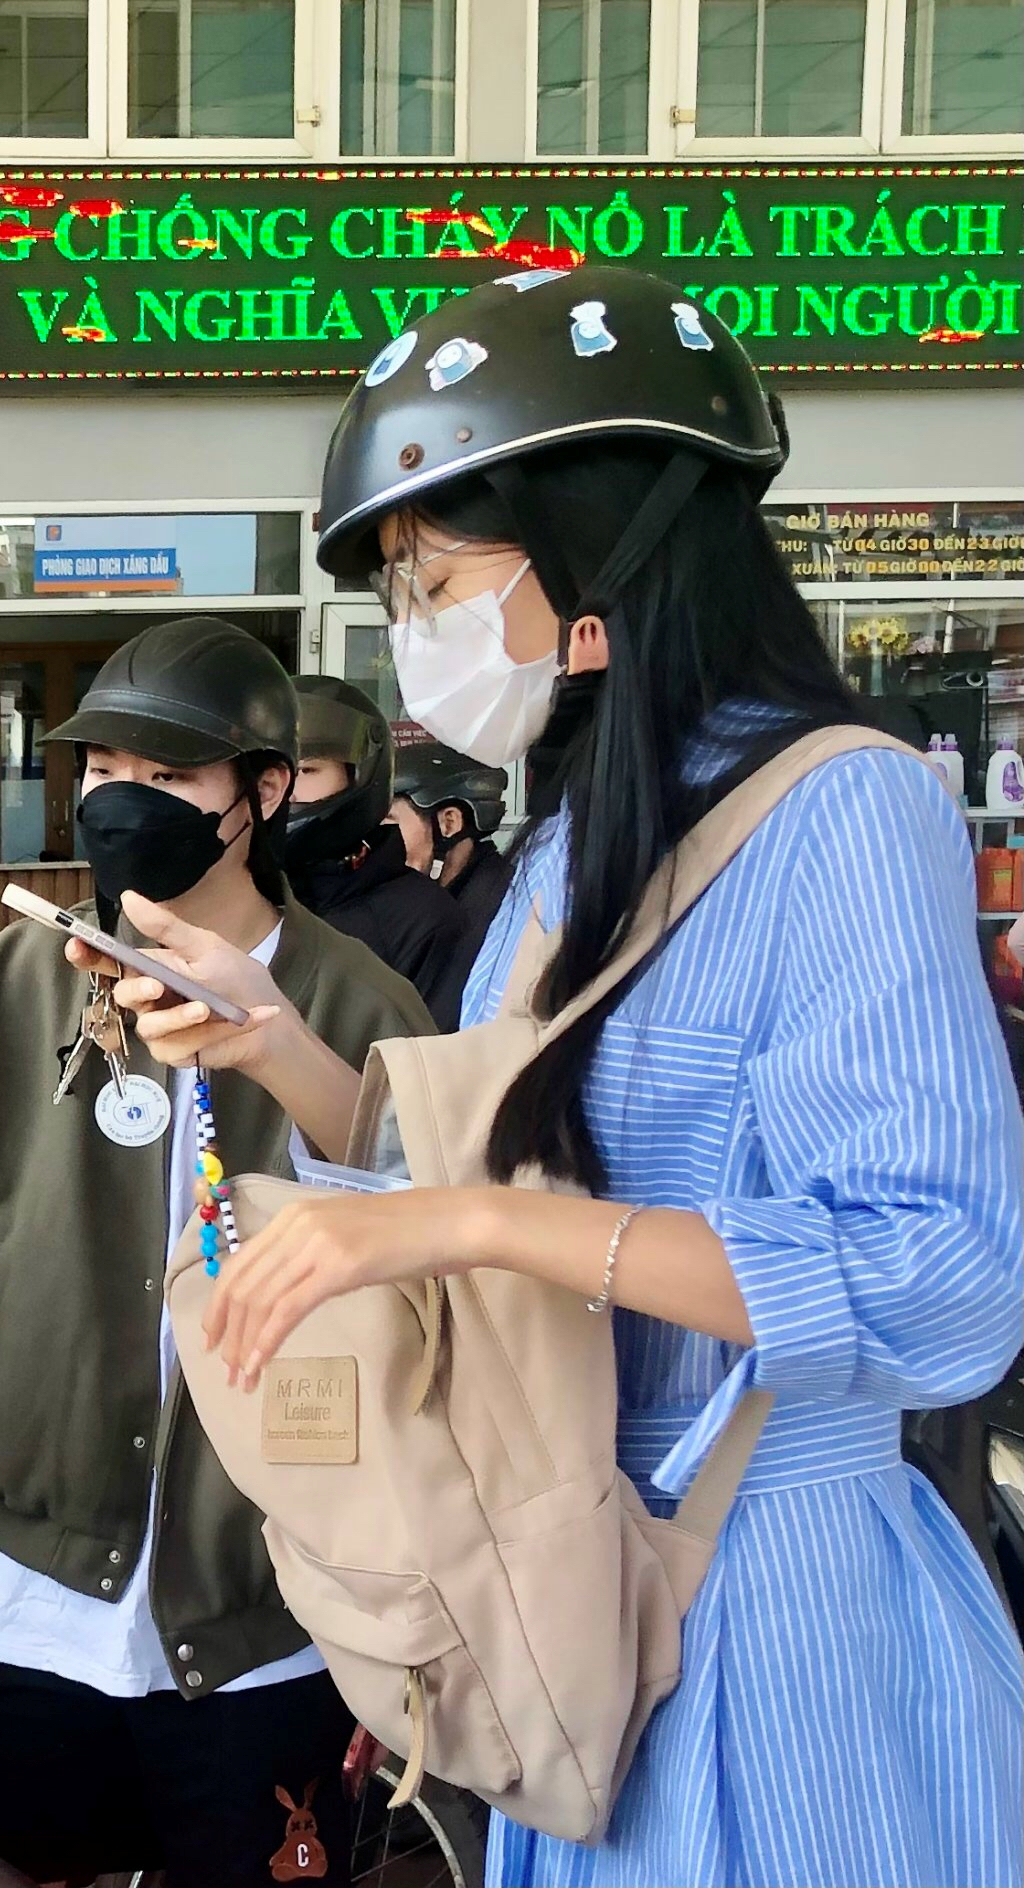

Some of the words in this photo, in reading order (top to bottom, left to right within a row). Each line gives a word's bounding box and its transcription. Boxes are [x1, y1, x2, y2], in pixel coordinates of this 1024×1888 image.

[54, 192, 313, 261] CHỐNG
[329, 190, 530, 260] CHÁY
[662, 190, 753, 257] LÀ
[769, 188, 1006, 256] TRÁCH
[18, 276, 117, 343] VÀ
[133, 276, 363, 342] NGHĨA
[792, 269, 1022, 337] NGƯỜI
[785, 512, 821, 530] GIỜ
[827, 510, 868, 529] BÁN
[874, 509, 930, 528] HÀNG
[42, 554, 74, 576] PHÒNG
[75, 558, 97, 576] GIAO
[98, 557, 121, 579] DỊCH
[123, 553, 148, 575] XĂNG
[284, 1402, 331, 1421] Leisure
[297, 1843, 309, 1867] C
